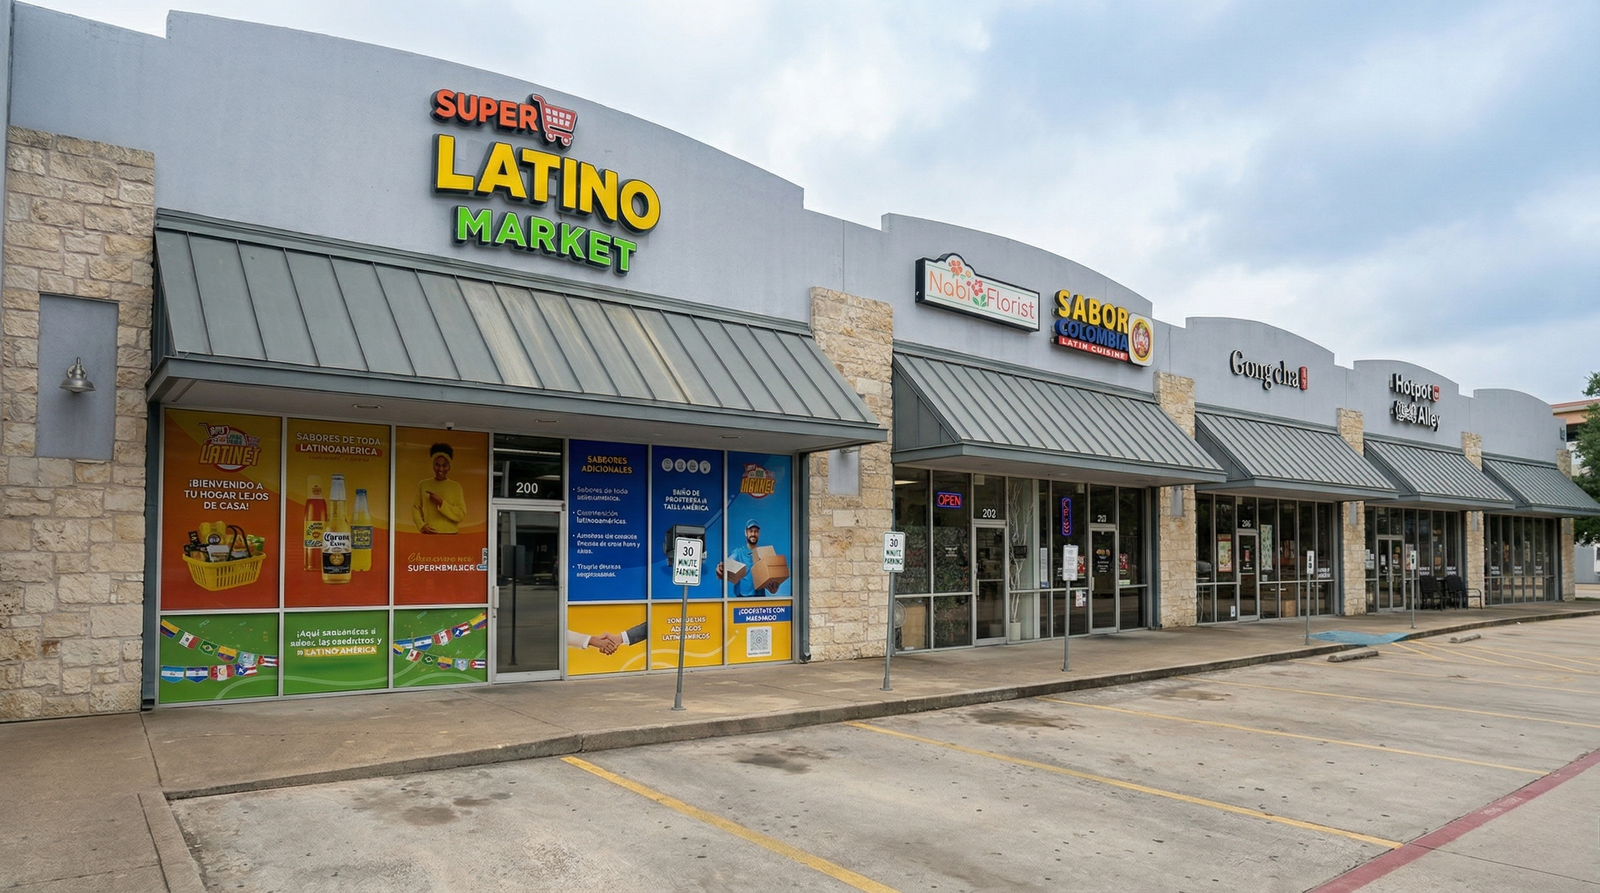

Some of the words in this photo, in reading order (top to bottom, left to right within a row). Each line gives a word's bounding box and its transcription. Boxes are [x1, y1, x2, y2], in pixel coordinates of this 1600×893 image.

[434, 88, 538, 132] SUPER
[435, 134, 661, 231] LATINO
[456, 206, 637, 272] MARKET
[929, 271, 971, 301] Nabi
[986, 287, 1035, 320] Florist
[1057, 289, 1129, 334] SABOR
[1057, 318, 1129, 351] COLOMBIA
[1062, 337, 1089, 351] LATIN
[1091, 345, 1126, 360] CUISINE
[1231, 349, 1273, 391] Gong
[1274, 360, 1300, 389] cha
[1395, 375, 1432, 402] Hotpot
[1417, 405, 1442, 432] Alley
[296, 432, 341, 443] SABORES
[343, 436, 355, 444] DE
[356, 437, 381, 446] TODA
[300, 443, 378, 456] LATINOAMERICA
[581, 465, 633, 474] ADICIONALES
[189, 479, 255, 490] ¡BIENVENIDO
[256, 482, 264, 490] A
[516, 482, 539, 494] 200
[184, 490, 198, 499] TU
[200, 490, 237, 500] HOGAR
[239, 492, 269, 501] LEJOS
[937, 494, 962, 507] OPEN
[203, 502, 217, 510] DE
[219, 502, 249, 511] CASA!
[982, 508, 997, 519] 202
[889, 538, 899, 548] 30
[682, 546, 694, 557] 30
